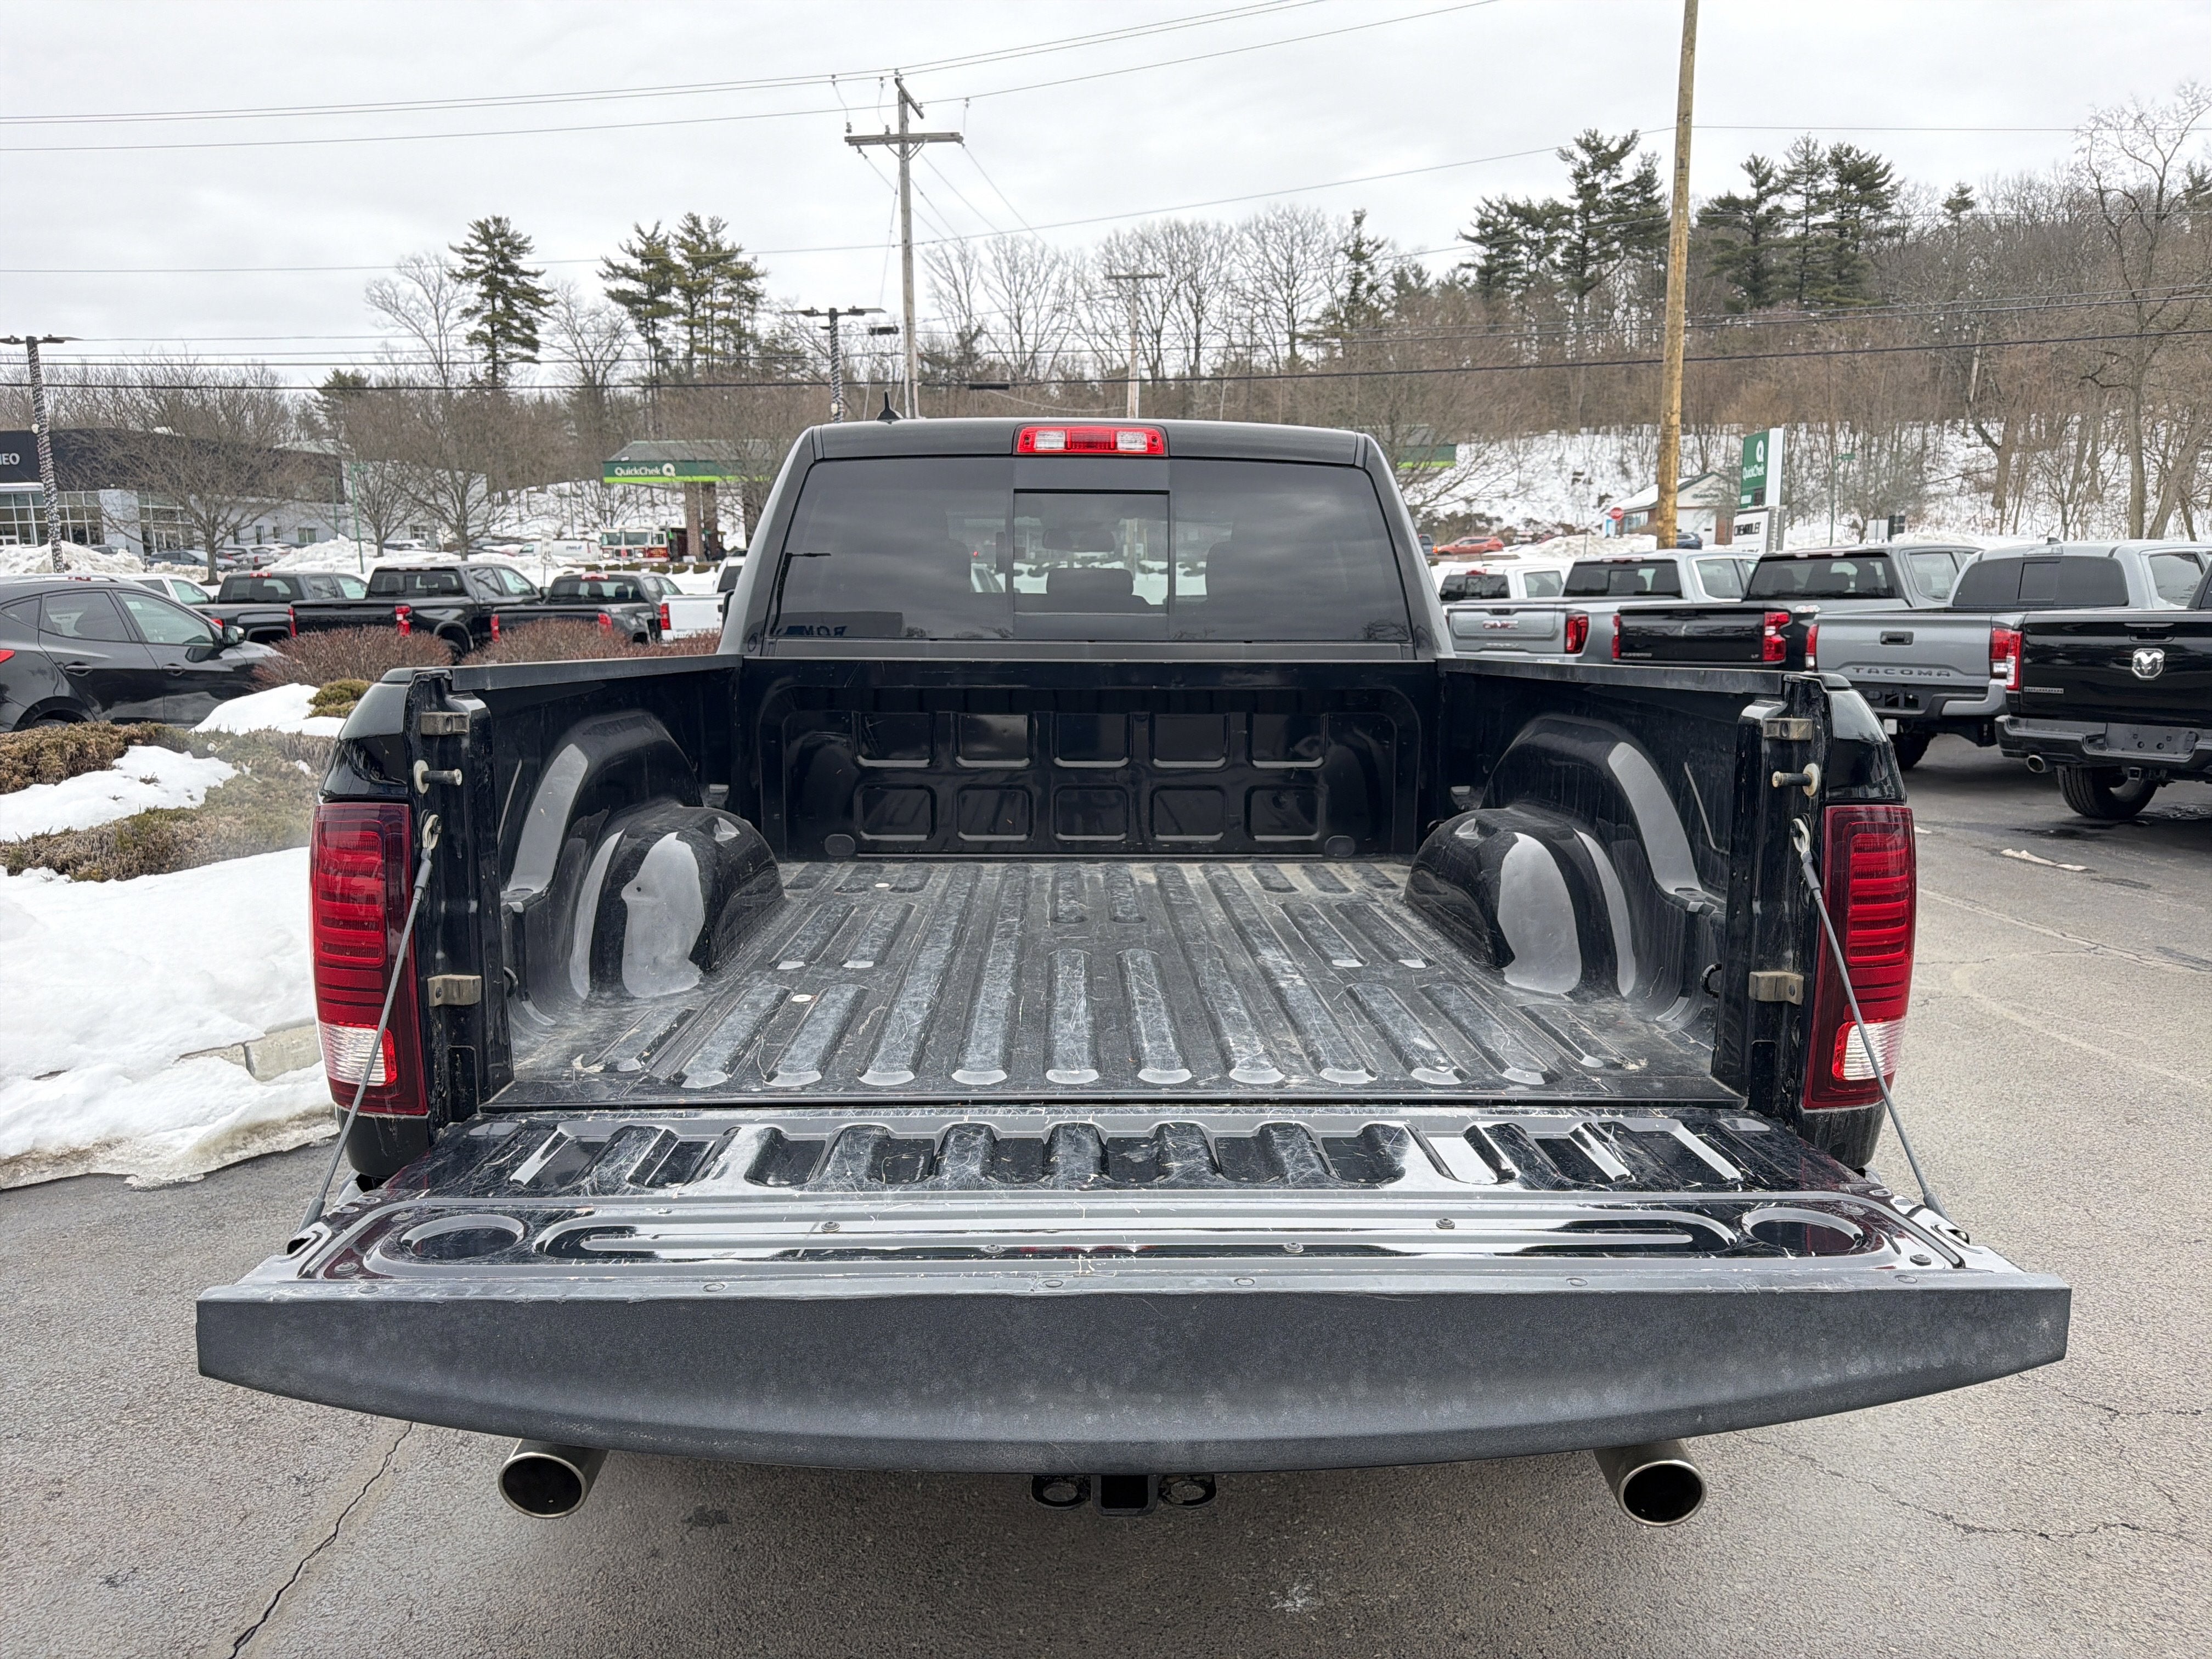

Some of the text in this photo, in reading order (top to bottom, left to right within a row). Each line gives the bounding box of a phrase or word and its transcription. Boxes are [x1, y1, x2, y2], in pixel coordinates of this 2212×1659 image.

[0, 453, 20, 465] EO
[614, 466, 661, 476] QuickChek
[1853, 667, 1950, 677] TACOMA
